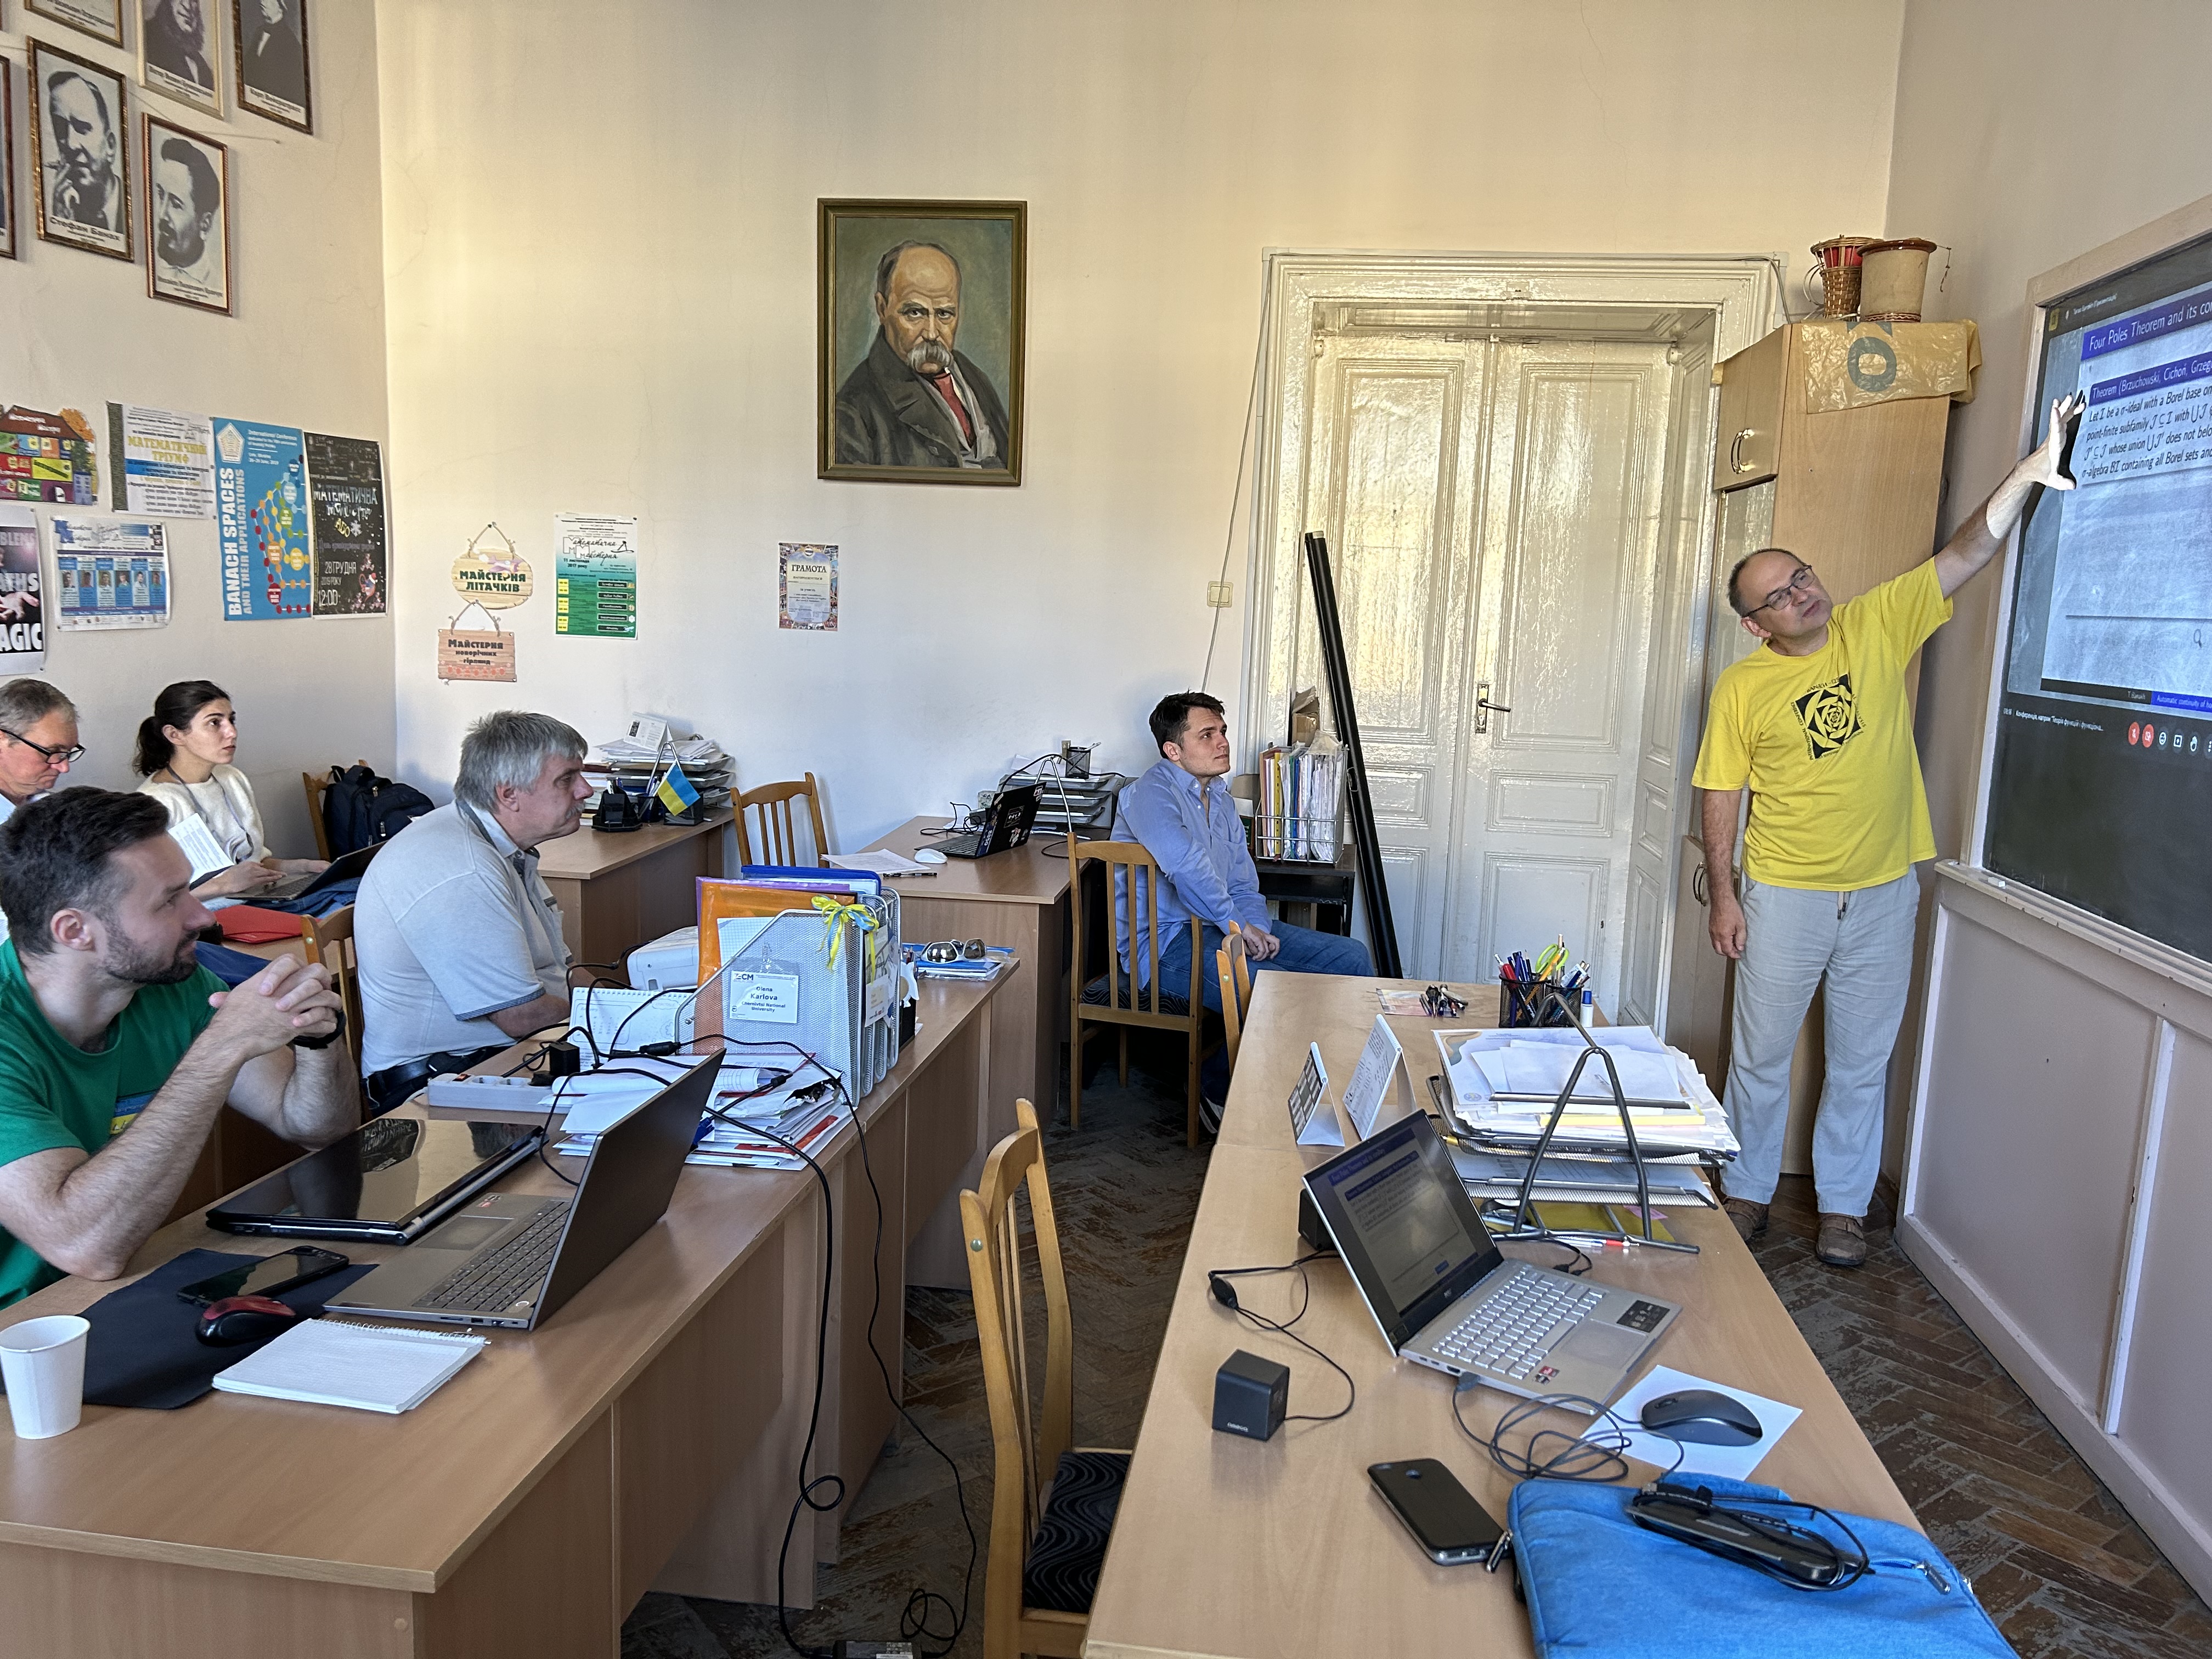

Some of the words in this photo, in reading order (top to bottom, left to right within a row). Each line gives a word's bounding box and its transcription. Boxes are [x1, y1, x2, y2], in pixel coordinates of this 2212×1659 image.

[2089, 336, 2106, 351] Four
[2108, 327, 2128, 345] Poles
[2131, 317, 2165, 337] Theorem
[2168, 307, 2183, 325] and
[2186, 304, 2197, 319] its
[2093, 385, 2117, 398] Theorem
[2089, 409, 2099, 422] Let
[2107, 408, 2114, 418] be
[2144, 396, 2158, 410] with
[2166, 388, 2185, 404] Borel
[2186, 387, 2201, 400] base
[2086, 426, 2118, 443] point-finite
[2119, 415, 2149, 433] subfamily
[2175, 410, 2189, 423] with
[2109, 443, 2126, 455] whose
[2128, 438, 2146, 451] union
[2165, 431, 2182, 444] does
[2183, 428, 2195, 441] not
[2121, 455, 2154, 470] containing
[2155, 452, 2164, 466] all
[2165, 448, 2184, 465] Borel
[2185, 449, 2198, 461] sets
[221, 467, 238, 539] SPACES
[235, 469, 249, 552] APPLICATIONS
[335, 518, 351, 538] АБО
[225, 541, 242, 615] BANACH
[240, 553, 250, 590] THEIR
[325, 561, 332, 574] 28
[460, 569, 526, 582] МАЙСТЕРНЯ
[791, 564, 827, 573] ГРАМОТА
[318, 589, 338, 606] 12:00
[466, 582, 520, 592] ЛІТАЧКІВ
[242, 590, 252, 615] AND
